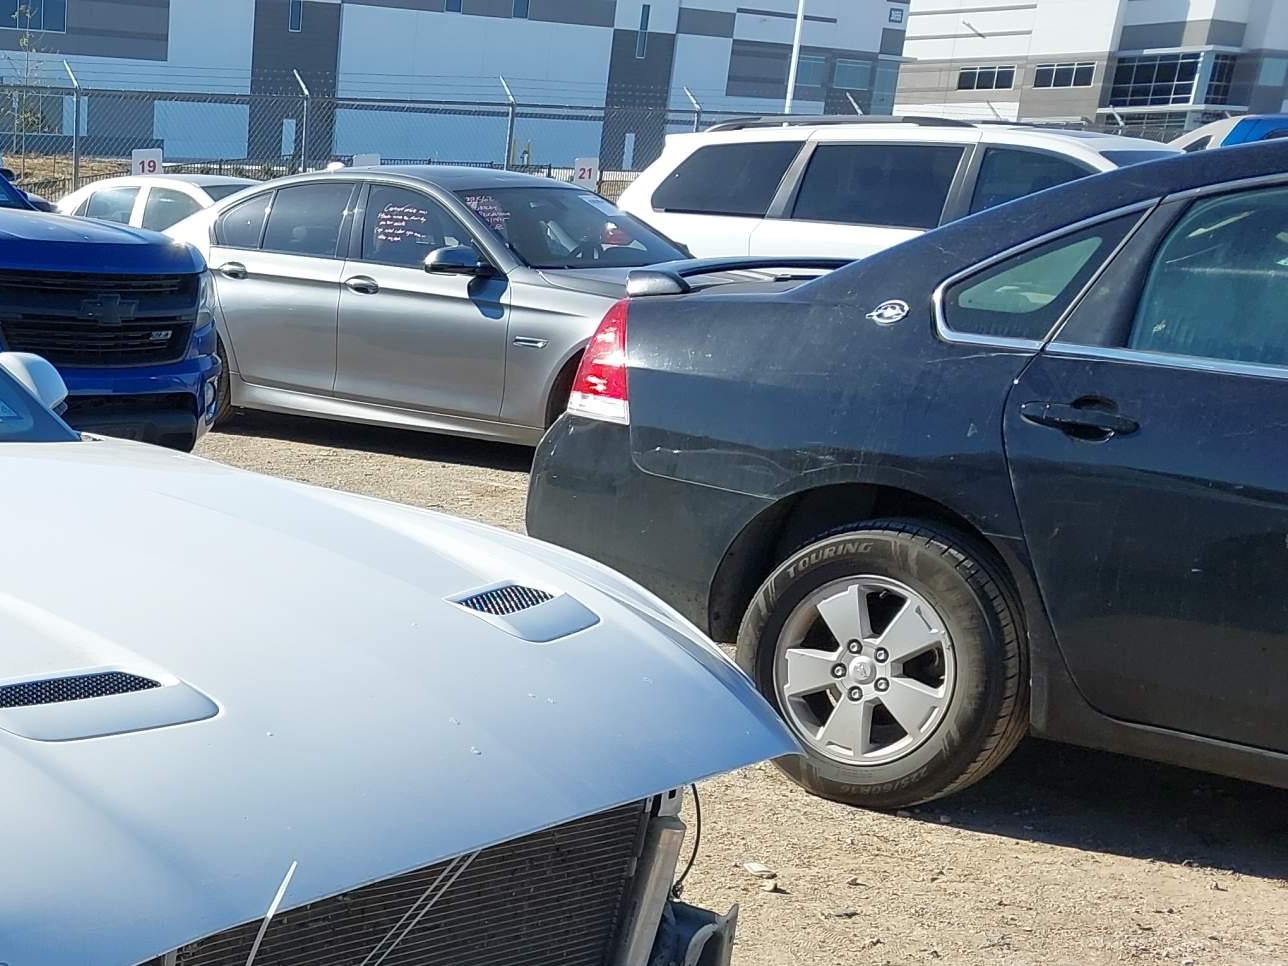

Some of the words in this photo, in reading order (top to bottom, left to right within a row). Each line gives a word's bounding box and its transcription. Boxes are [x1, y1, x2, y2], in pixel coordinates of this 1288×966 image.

[139, 160, 157, 173] 19
[578, 167, 592, 180] 21
[785, 542, 874, 578] TOURING
